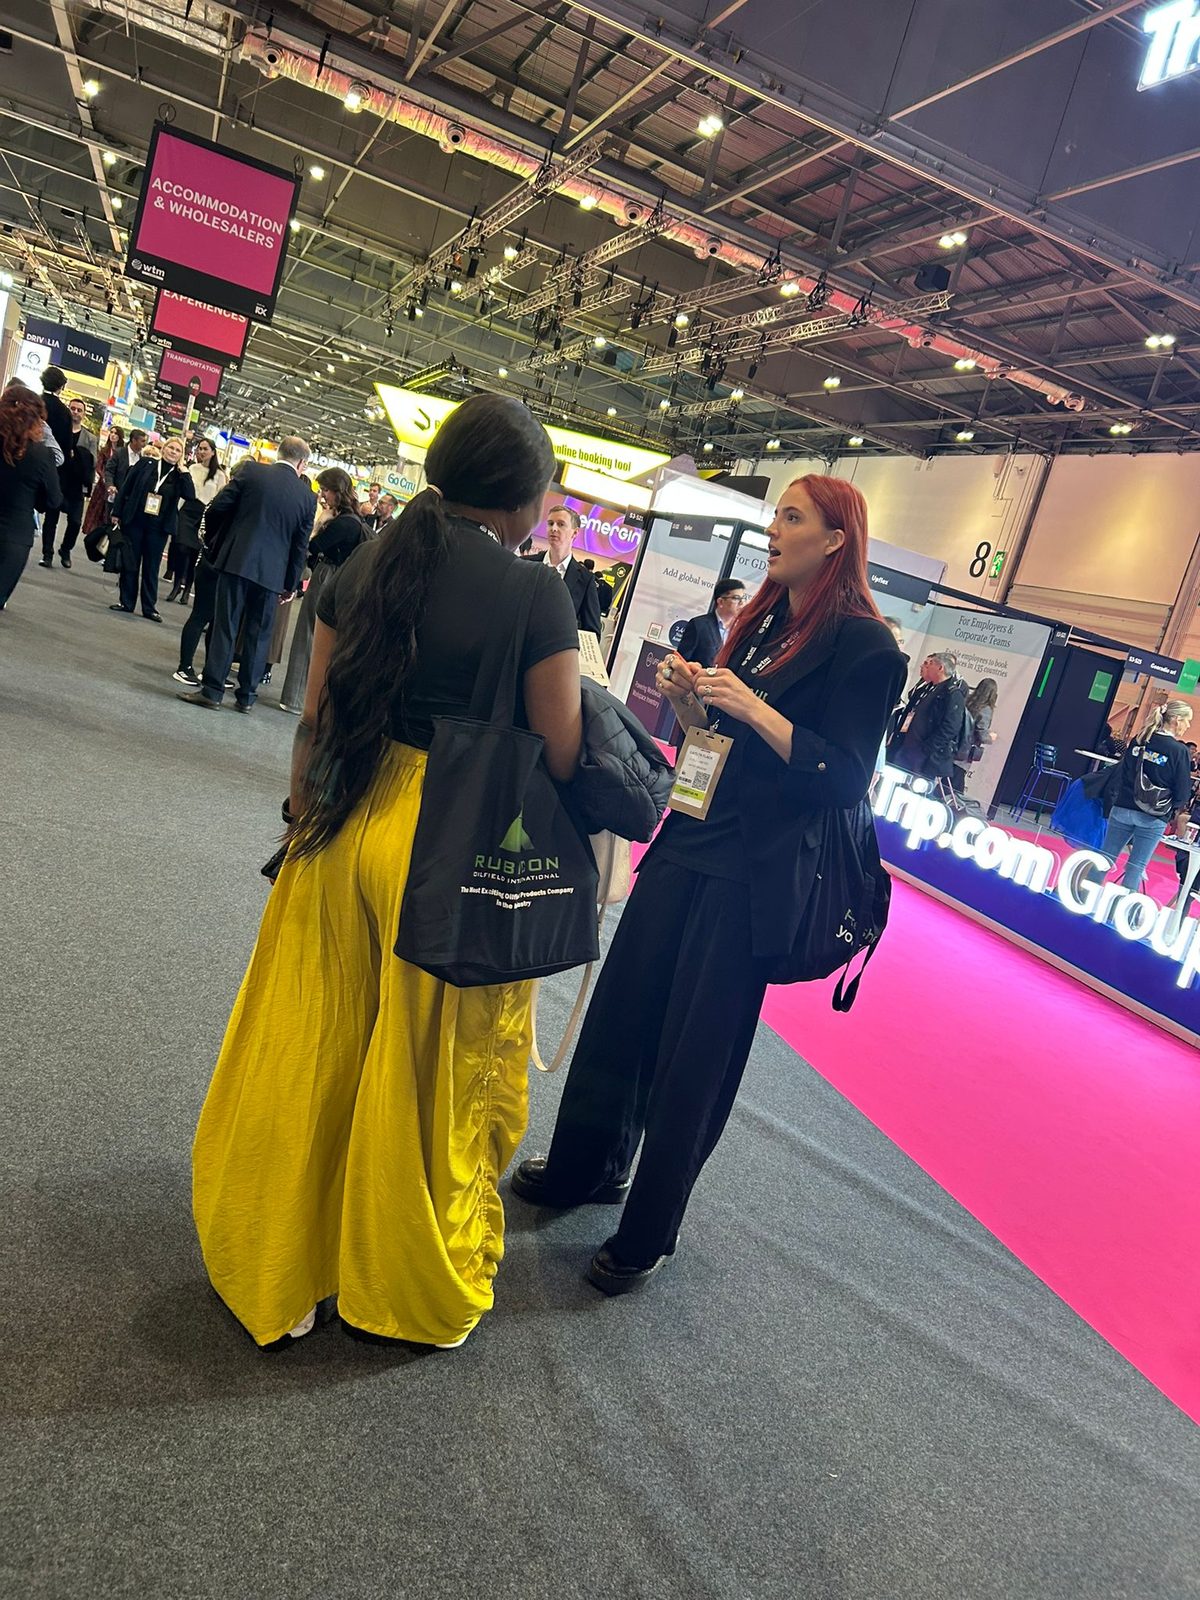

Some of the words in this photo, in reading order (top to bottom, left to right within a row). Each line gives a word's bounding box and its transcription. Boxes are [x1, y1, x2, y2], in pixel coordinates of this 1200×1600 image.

[151, 177, 283, 236] ACCOMMODATION
[153, 196, 165, 209] &
[169, 199, 275, 249] WHOLESALERS
[143, 263, 165, 277] wtm
[26, 333, 60, 348] DRIVALIA
[66, 344, 104, 364] DRIVALIA
[166, 351, 220, 375] TRANSPORTATION
[578, 449, 613, 470] booking
[614, 459, 632, 472] tool
[968, 541, 992, 578] 8
[662, 567, 678, 578] Add
[678, 572, 700, 585] global
[958, 615, 970, 625] For
[970, 617, 1008, 634] Employers
[1007, 624, 1015, 634] &
[954, 628, 988, 643] Corporate
[989, 634, 1012, 648] Teams
[961, 654, 988, 665] employees
[988, 658, 995, 666] to
[995, 658, 1008, 669] book
[983, 666, 1008, 678] countries
[872, 764, 1056, 893] Trip.com
[473, 871, 505, 883] OILFIELD
[507, 872, 560, 884] INTATIONAL
[469, 886, 481, 894] Most
[520, 889, 547, 898] Products
[547, 887, 574, 895] Company
[502, 901, 513, 909] the
[835, 924, 854, 945] yo
